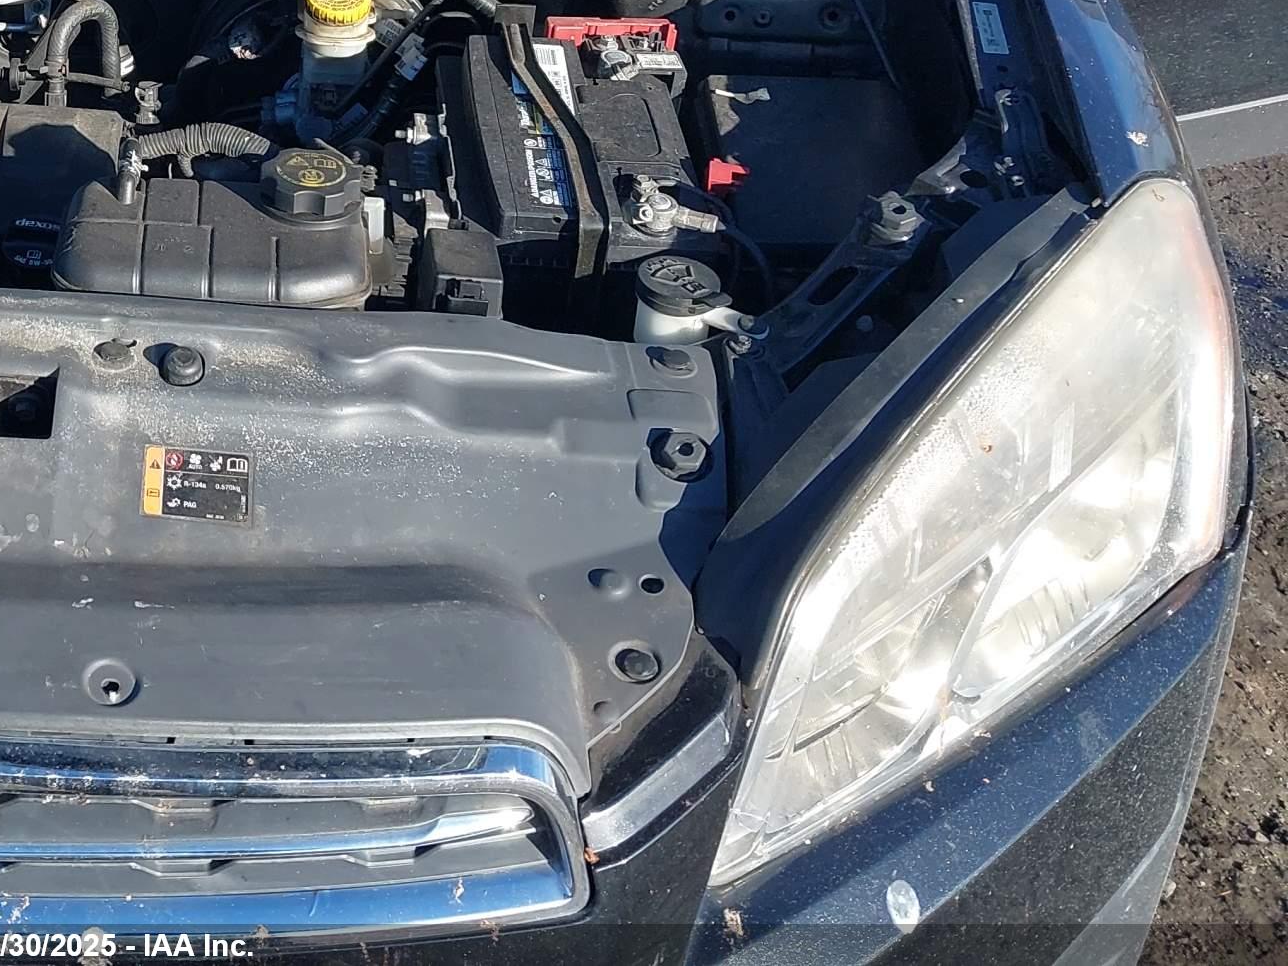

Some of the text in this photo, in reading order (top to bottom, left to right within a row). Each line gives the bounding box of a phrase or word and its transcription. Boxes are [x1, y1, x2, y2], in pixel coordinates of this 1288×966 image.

[15, 218, 61, 231] dexos
[183, 480, 207, 489] R-134a
[183, 500, 197, 509] PAG
